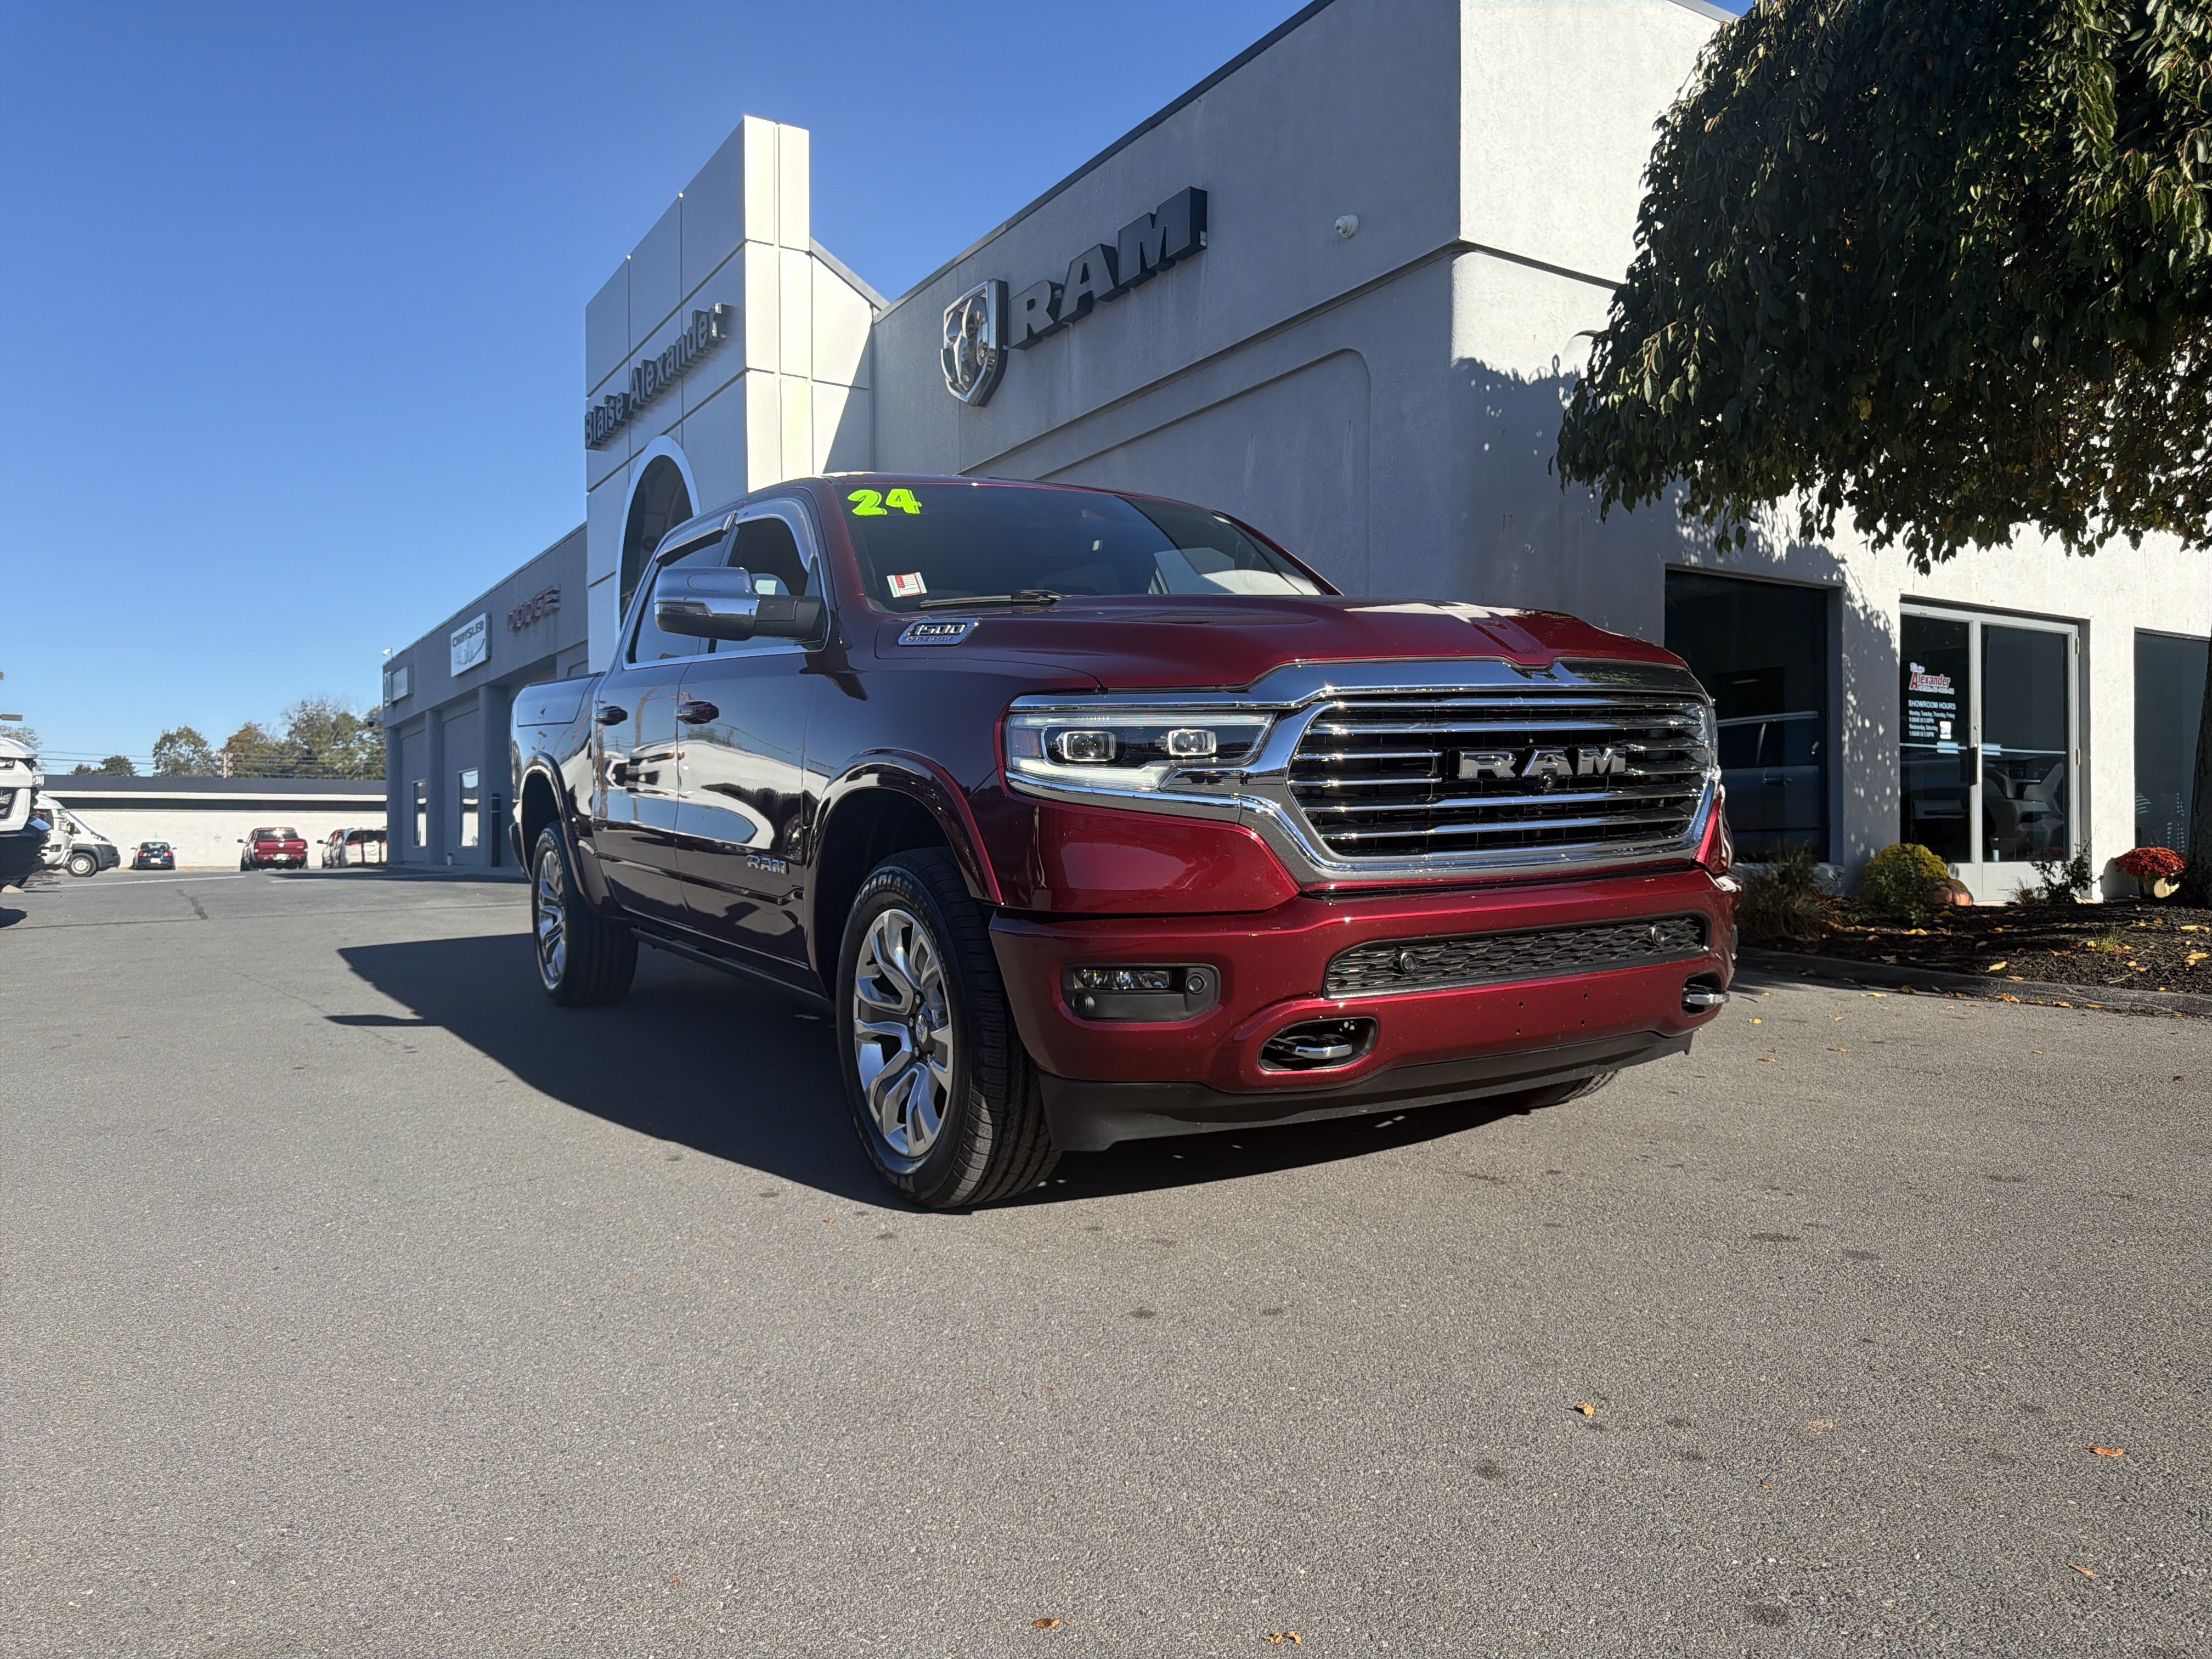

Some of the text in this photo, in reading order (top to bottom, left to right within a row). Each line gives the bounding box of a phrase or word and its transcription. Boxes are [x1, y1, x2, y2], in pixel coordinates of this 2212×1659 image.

[1009, 186, 1205, 350] RAM
[585, 303, 726, 450] Blaise Alexander
[847, 488, 922, 516] 24
[507, 585, 561, 631] DODGE
[453, 620, 484, 647] CHRYSLER
[913, 624, 966, 635] 1500
[1909, 672, 1950, 690] Alexander
[1908, 699, 1938, 709] SHOWROOM
[1459, 747, 1626, 779] RAM
[747, 854, 788, 874] RAM
